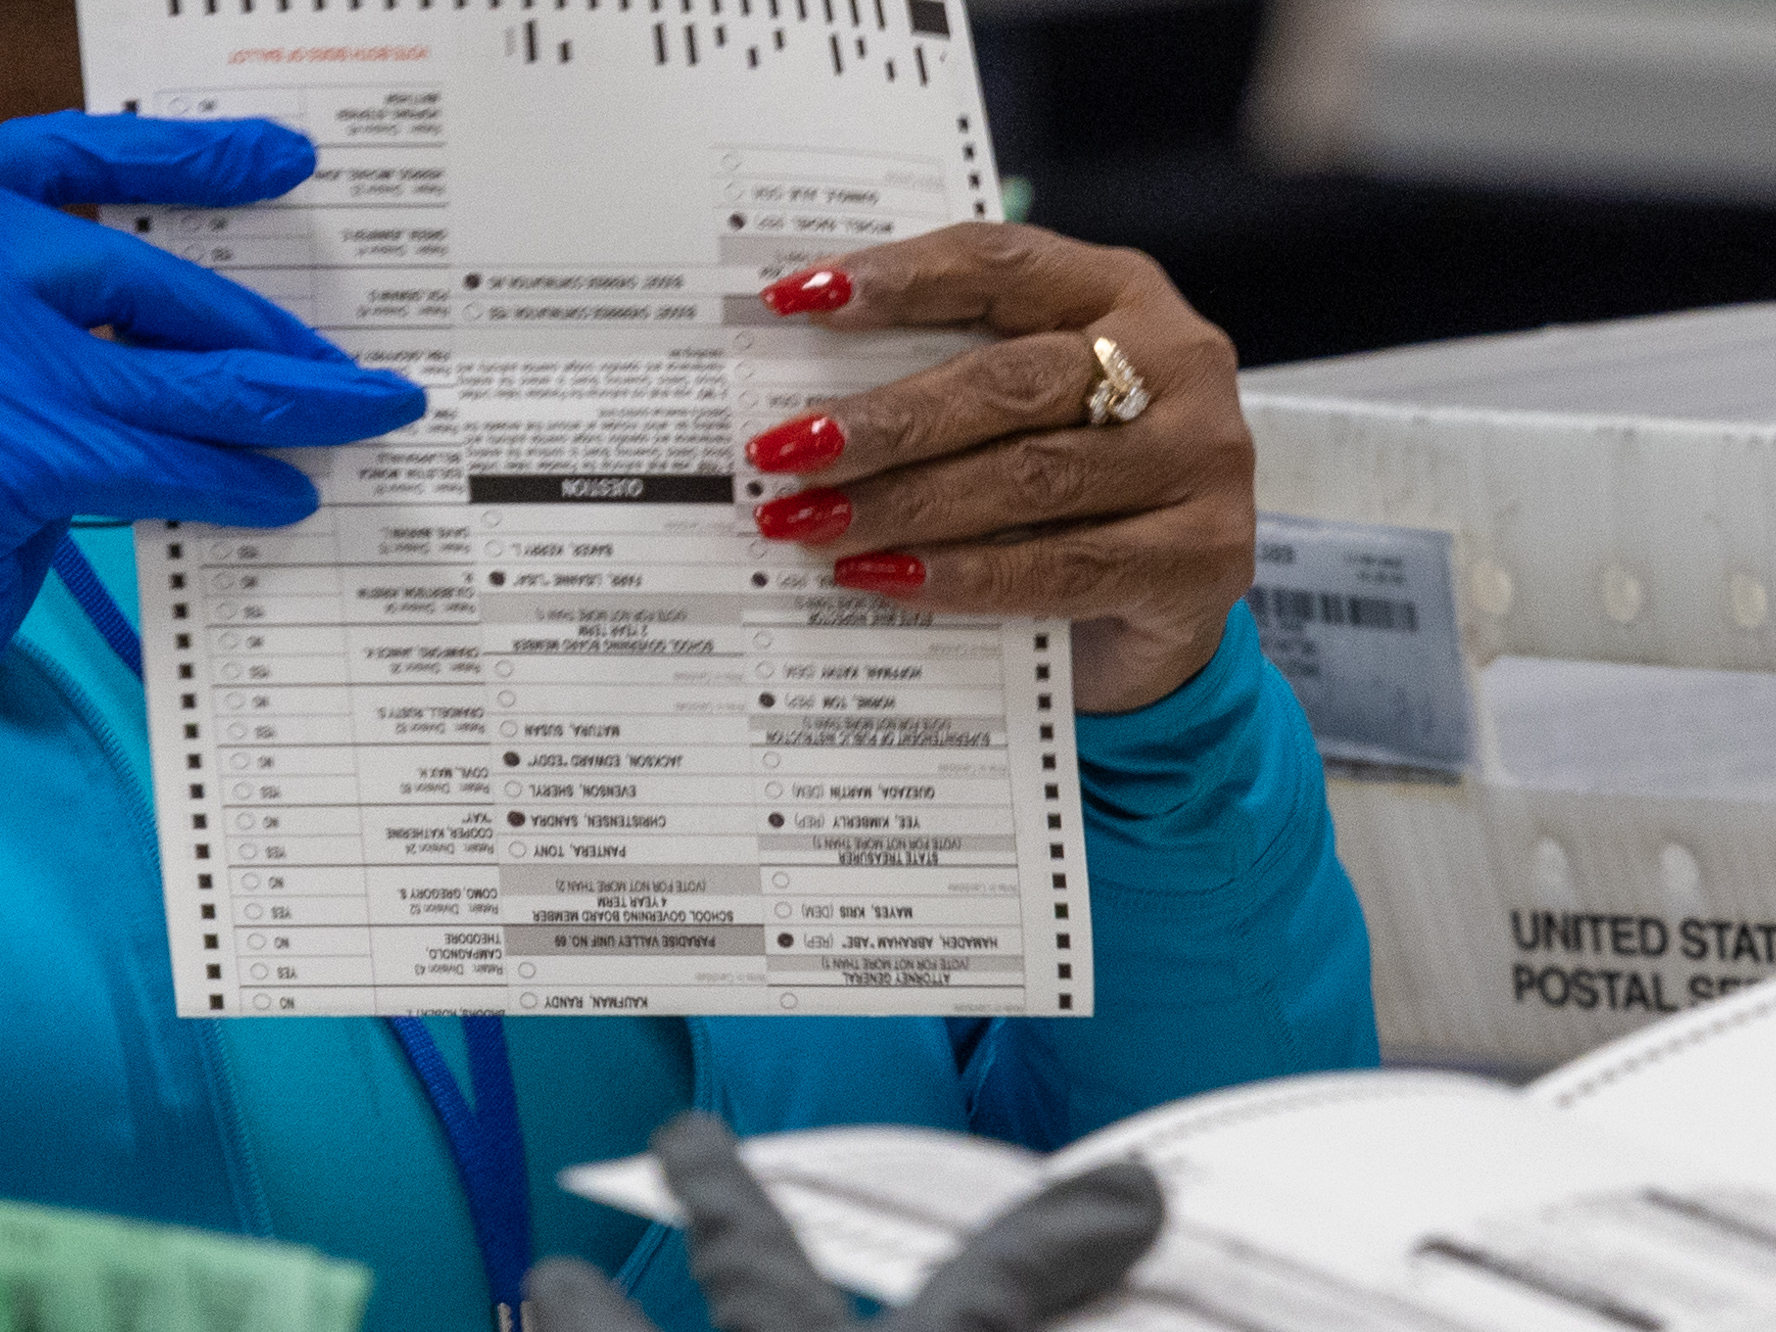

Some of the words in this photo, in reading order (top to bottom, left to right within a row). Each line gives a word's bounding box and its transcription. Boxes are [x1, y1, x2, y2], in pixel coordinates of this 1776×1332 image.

[524, 724, 564, 738] SUSAN
[569, 723, 620, 738] MATURA,
[529, 785, 574, 798] SHERYL
[579, 783, 637, 798] EVENSON,
[531, 816, 578, 827] SANDRA
[584, 814, 666, 827] CHRISTENSEN,
[794, 813, 825, 828] (REP)
[833, 815, 889, 828] KIMBERLY
[894, 814, 920, 828] YEE,
[385, 827, 445, 839] KATHERINE
[446, 826, 493, 839] COOPER,
[533, 846, 565, 857] TONY
[570, 844, 626, 857] PANTERA,
[838, 852, 903, 864] TREASURER
[904, 852, 939, 864] STATE
[555, 879, 565, 892] 2)
[566, 879, 594, 892] THAN
[597, 879, 626, 892] MORE
[628, 879, 650, 892] NOT
[652, 879, 674, 892] FOR
[676, 879, 707, 892] (VOTE
[597, 897, 626, 908] TERM
[630, 897, 660, 908] YEAR
[661, 897, 667, 908] 4
[271, 907, 293, 919] YES
[532, 910, 579, 922] MEMBER
[582, 910, 620, 922] BOARD
[623, 910, 686, 922] GOVERNING
[689, 910, 734, 922] SCHOOL
[801, 903, 834, 918] (DEM)
[839, 905, 865, 918] KRIS
[871, 904, 913, 918] MAYES,
[444, 933, 502, 944] THEODORE
[1510, 909, 1670, 957] UNITED
[274, 936, 290, 948] NO
[568, 935, 588, 947] NO.
[589, 935, 615, 947] UNIF
[617, 935, 660, 947] VALLEY
[662, 935, 716, 947] PARADISE
[803, 933, 834, 949] (REP)
[841, 936, 875, 949] "ABE"
[878, 936, 933, 949] ABRAHAM
[939, 934, 998, 949] HAMADEH,
[425, 947, 502, 959] CAMPAGNOLO,
[276, 967, 298, 980] YES
[842, 971, 892, 984] GENERAL
[895, 971, 951, 984] ATTORNEY
[1513, 963, 1680, 1014] POSTAL
[279, 997, 295, 1009] NO
[544, 996, 584, 1008] RANDY
[589, 995, 648, 1008] KAUFMAN,
